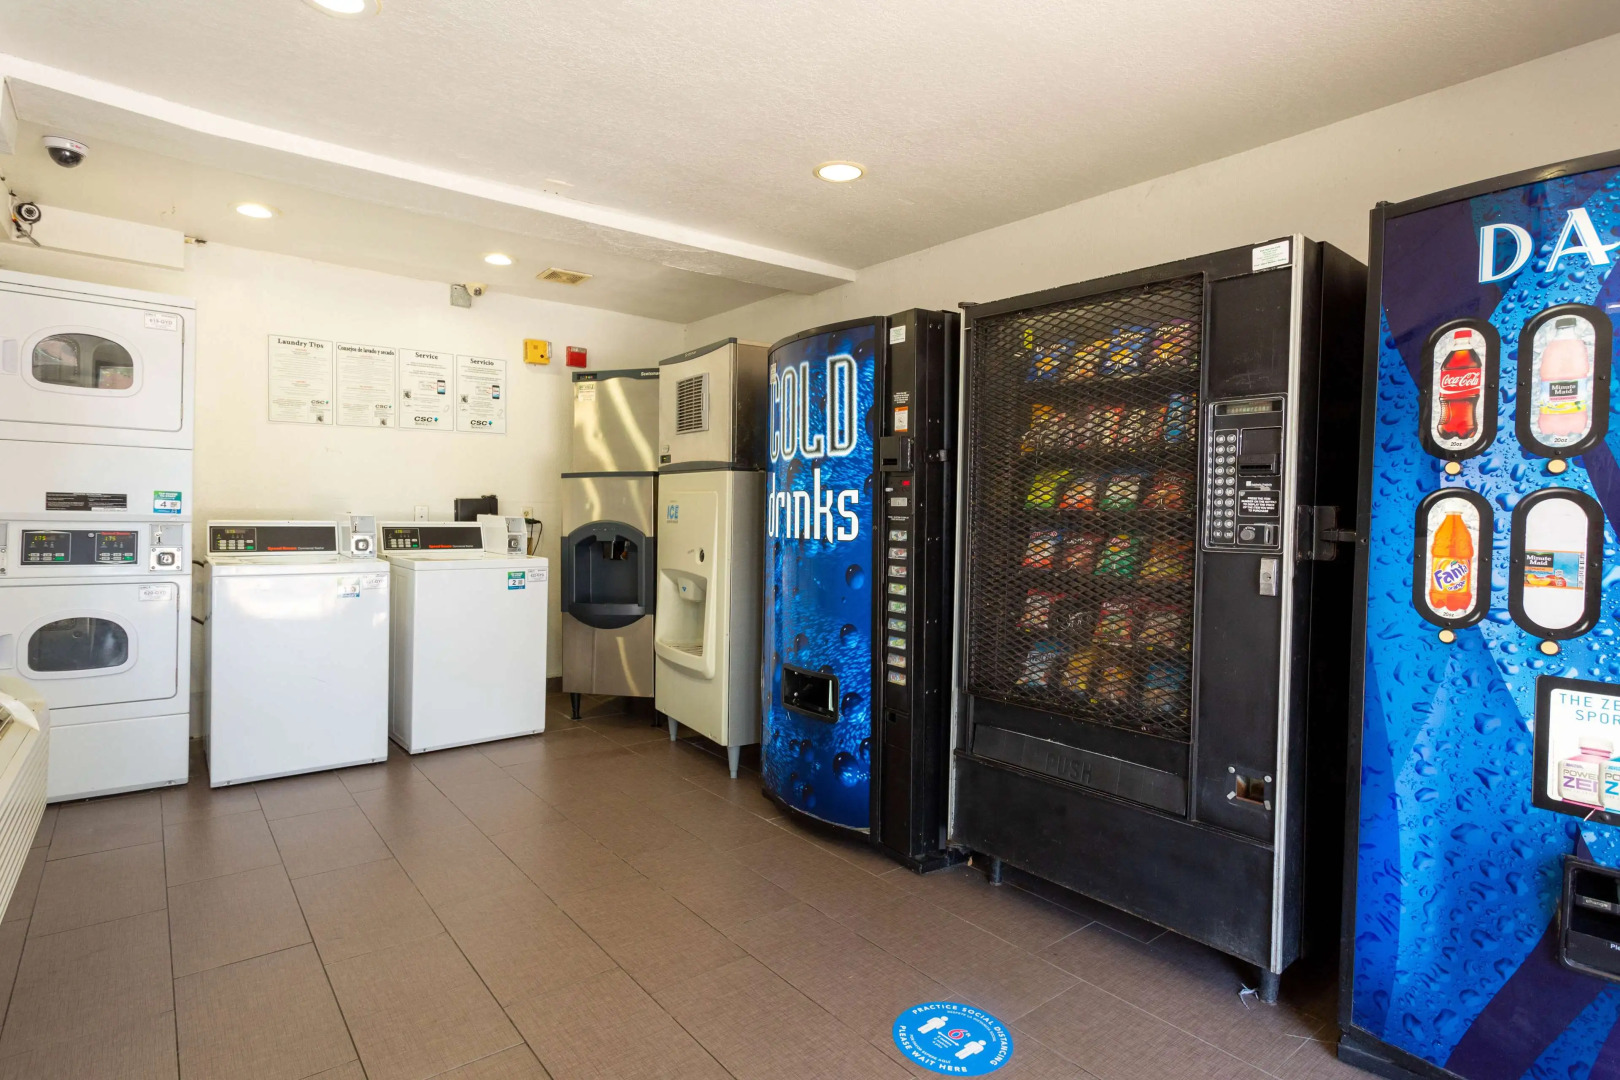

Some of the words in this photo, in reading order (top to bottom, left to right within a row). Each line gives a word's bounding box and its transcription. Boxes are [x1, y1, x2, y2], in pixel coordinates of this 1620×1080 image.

[278, 338, 307, 348] Laundry
[309, 341, 324, 349] Tips
[1442, 372, 1480, 388] Coca-Cola
[770, 354, 858, 463] COLD
[667, 505, 679, 520] ICE
[768, 468, 859, 544] drinks
[1434, 564, 1468, 590] Fanta
[1560, 693, 1592, 707] THE
[1045, 752, 1091, 784] PUSH
[912, 1004, 958, 1015] PRACTICE
[962, 1007, 994, 1026] SOCIAL
[990, 1026, 1008, 1066] DISTANCING
[948, 1029, 968, 1040] 6
[899, 1025, 912, 1050] PLEASE
[912, 1050, 936, 1066] WAIT
[939, 1064, 968, 1072] HERE
